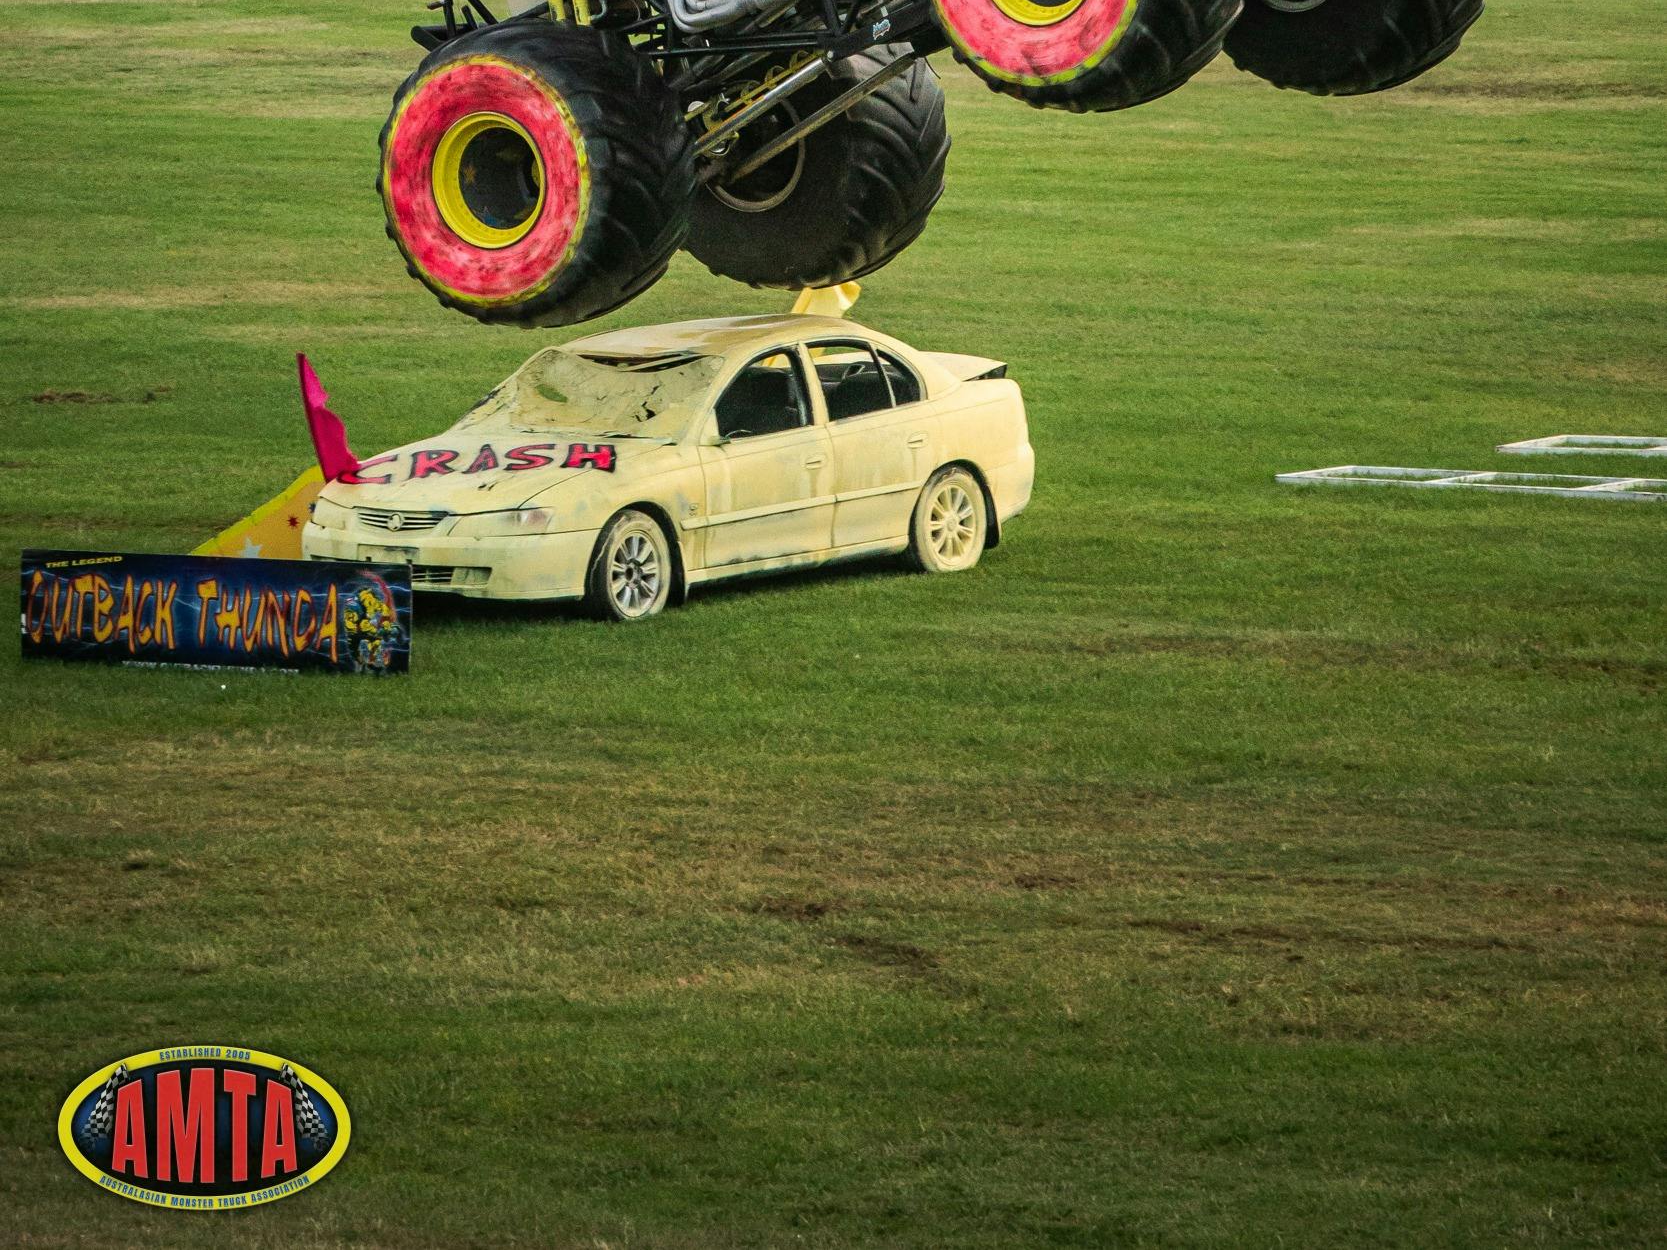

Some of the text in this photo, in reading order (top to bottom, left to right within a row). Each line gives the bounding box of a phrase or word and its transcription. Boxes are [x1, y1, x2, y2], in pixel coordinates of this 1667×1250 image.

[336, 443, 617, 485] CRASH
[46, 555, 123, 569] THE LEGEND
[26, 569, 339, 665] OUTBACK THUNDA
